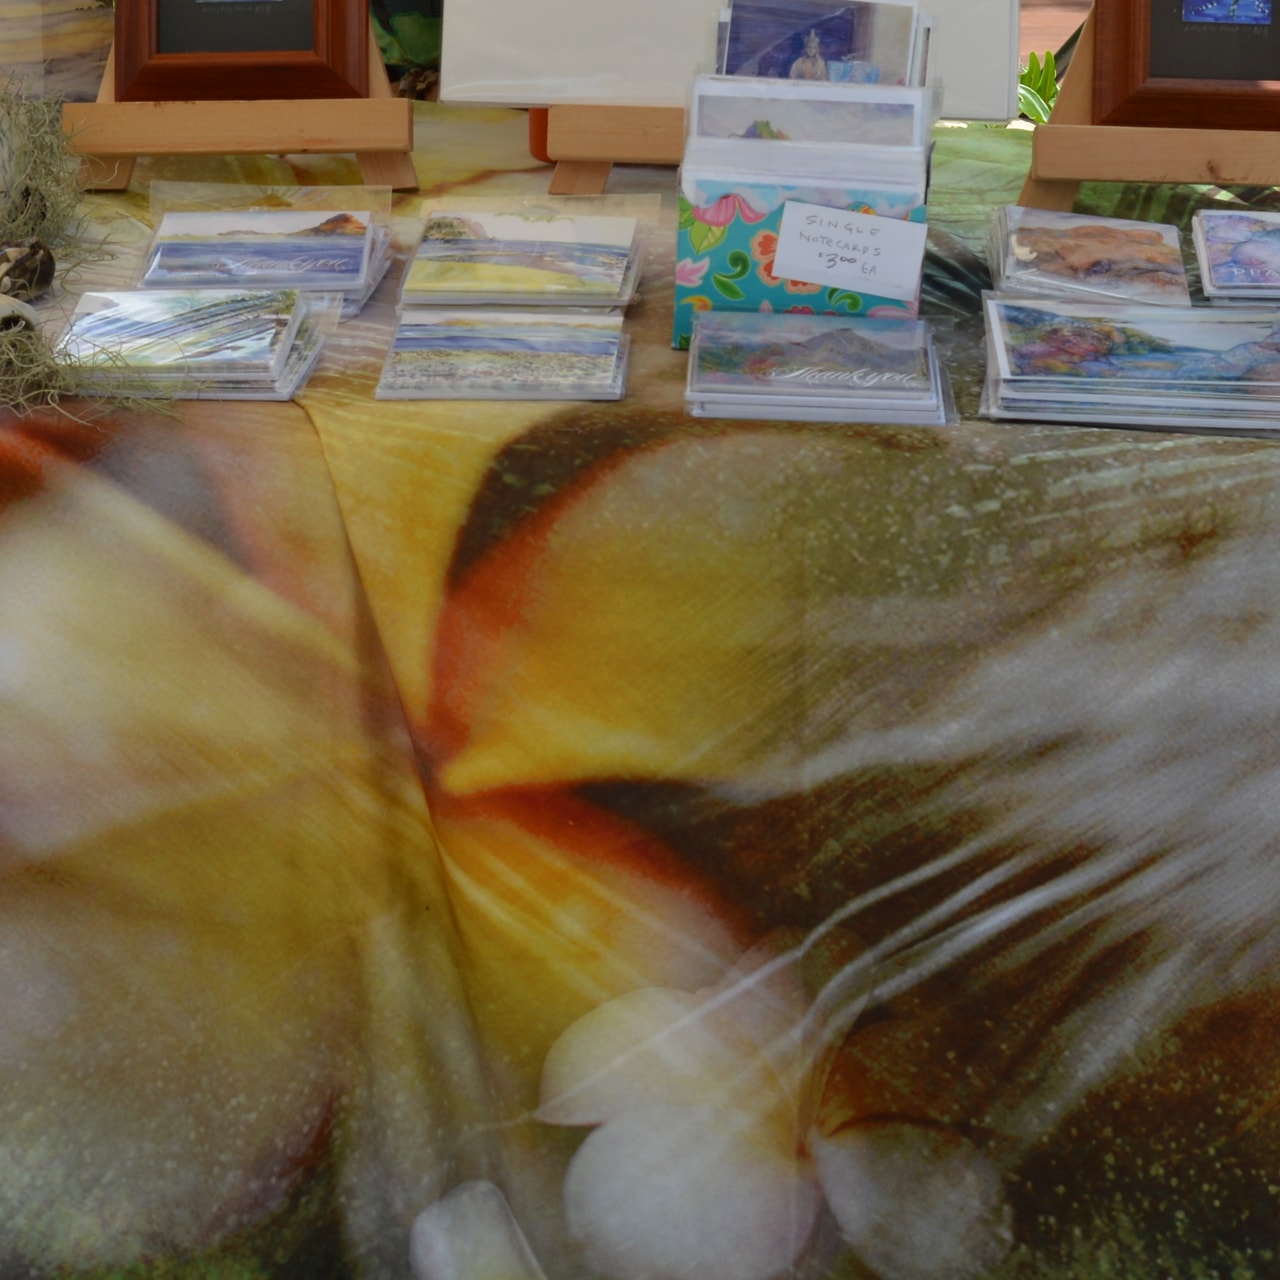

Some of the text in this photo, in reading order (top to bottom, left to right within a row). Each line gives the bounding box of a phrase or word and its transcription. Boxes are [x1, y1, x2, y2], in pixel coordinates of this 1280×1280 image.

[805, 215, 880, 236] SINGLE
[799, 231, 881, 257] NOTECARDS
[861, 262, 877, 276] EA
